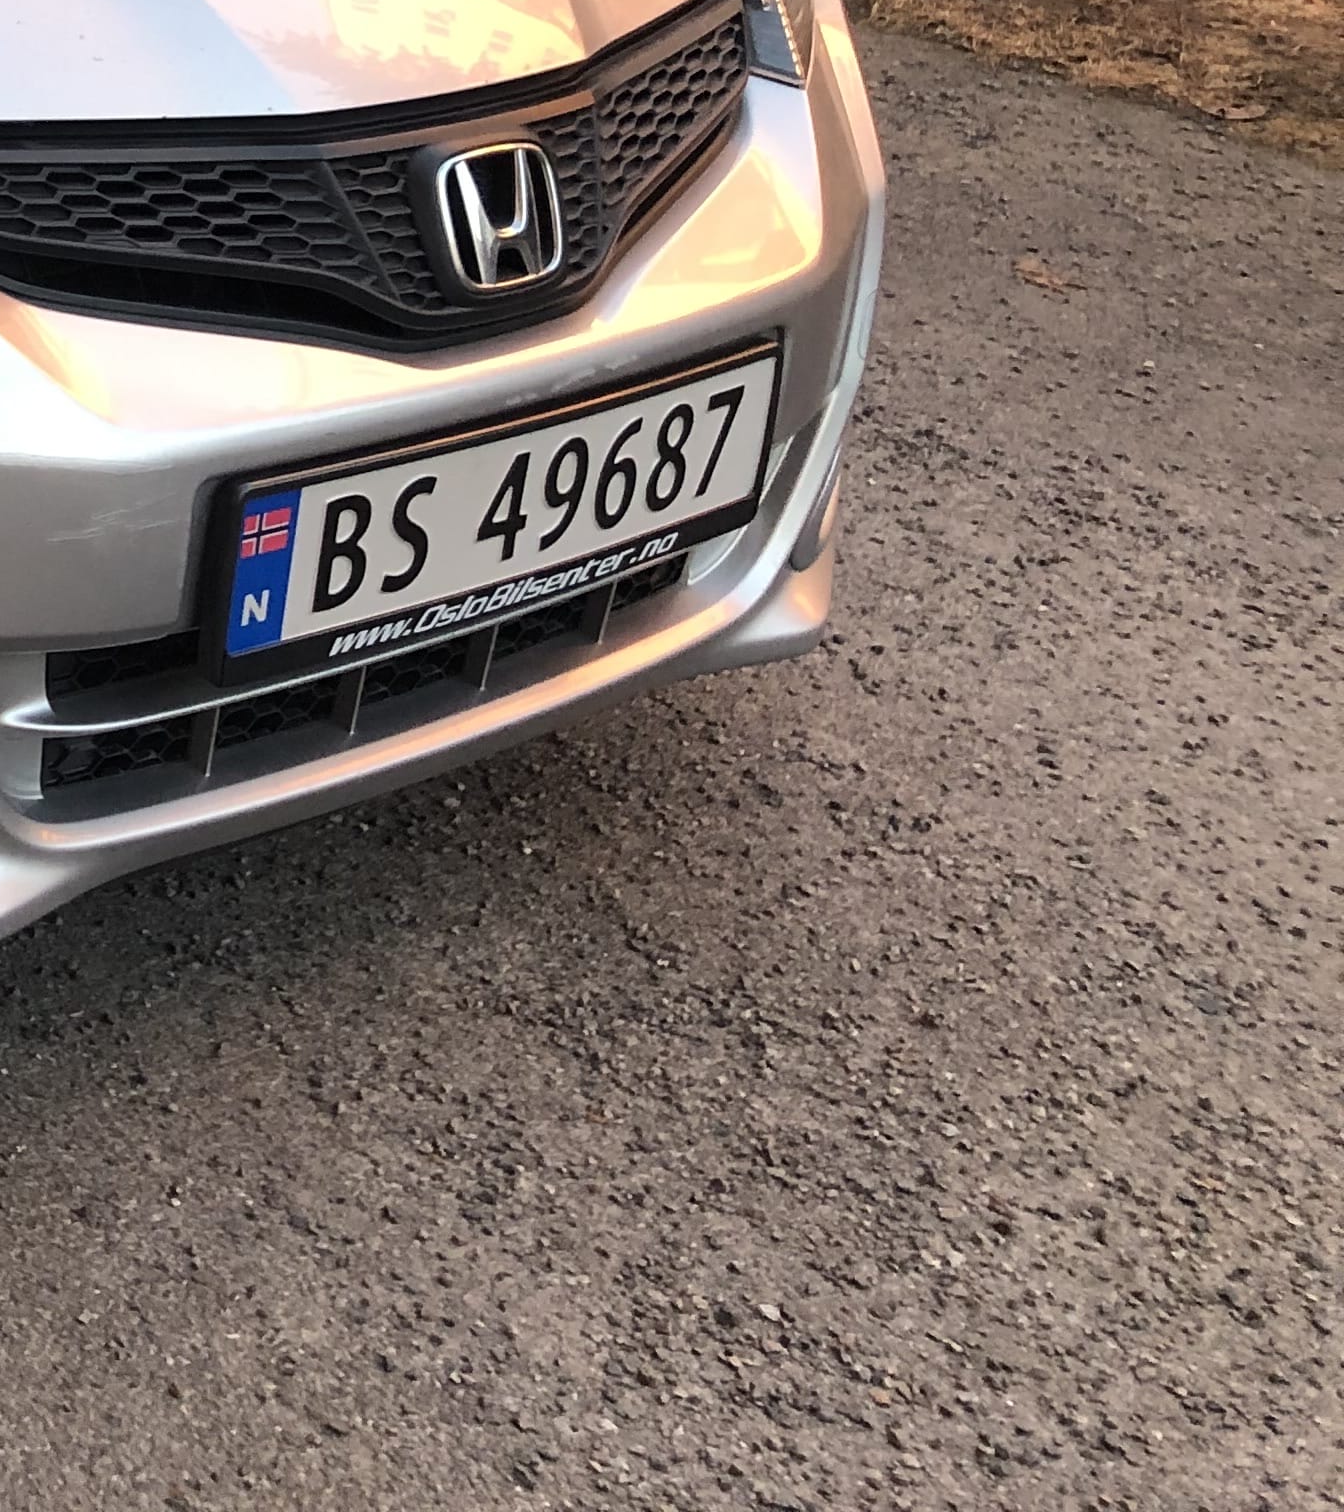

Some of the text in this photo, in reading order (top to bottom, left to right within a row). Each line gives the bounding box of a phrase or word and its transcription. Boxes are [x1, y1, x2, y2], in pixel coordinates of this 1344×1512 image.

[312, 384, 746, 613] BS 49687
[239, 589, 270, 627] N
[328, 531, 679, 658] www.OsloBilsenter.no
